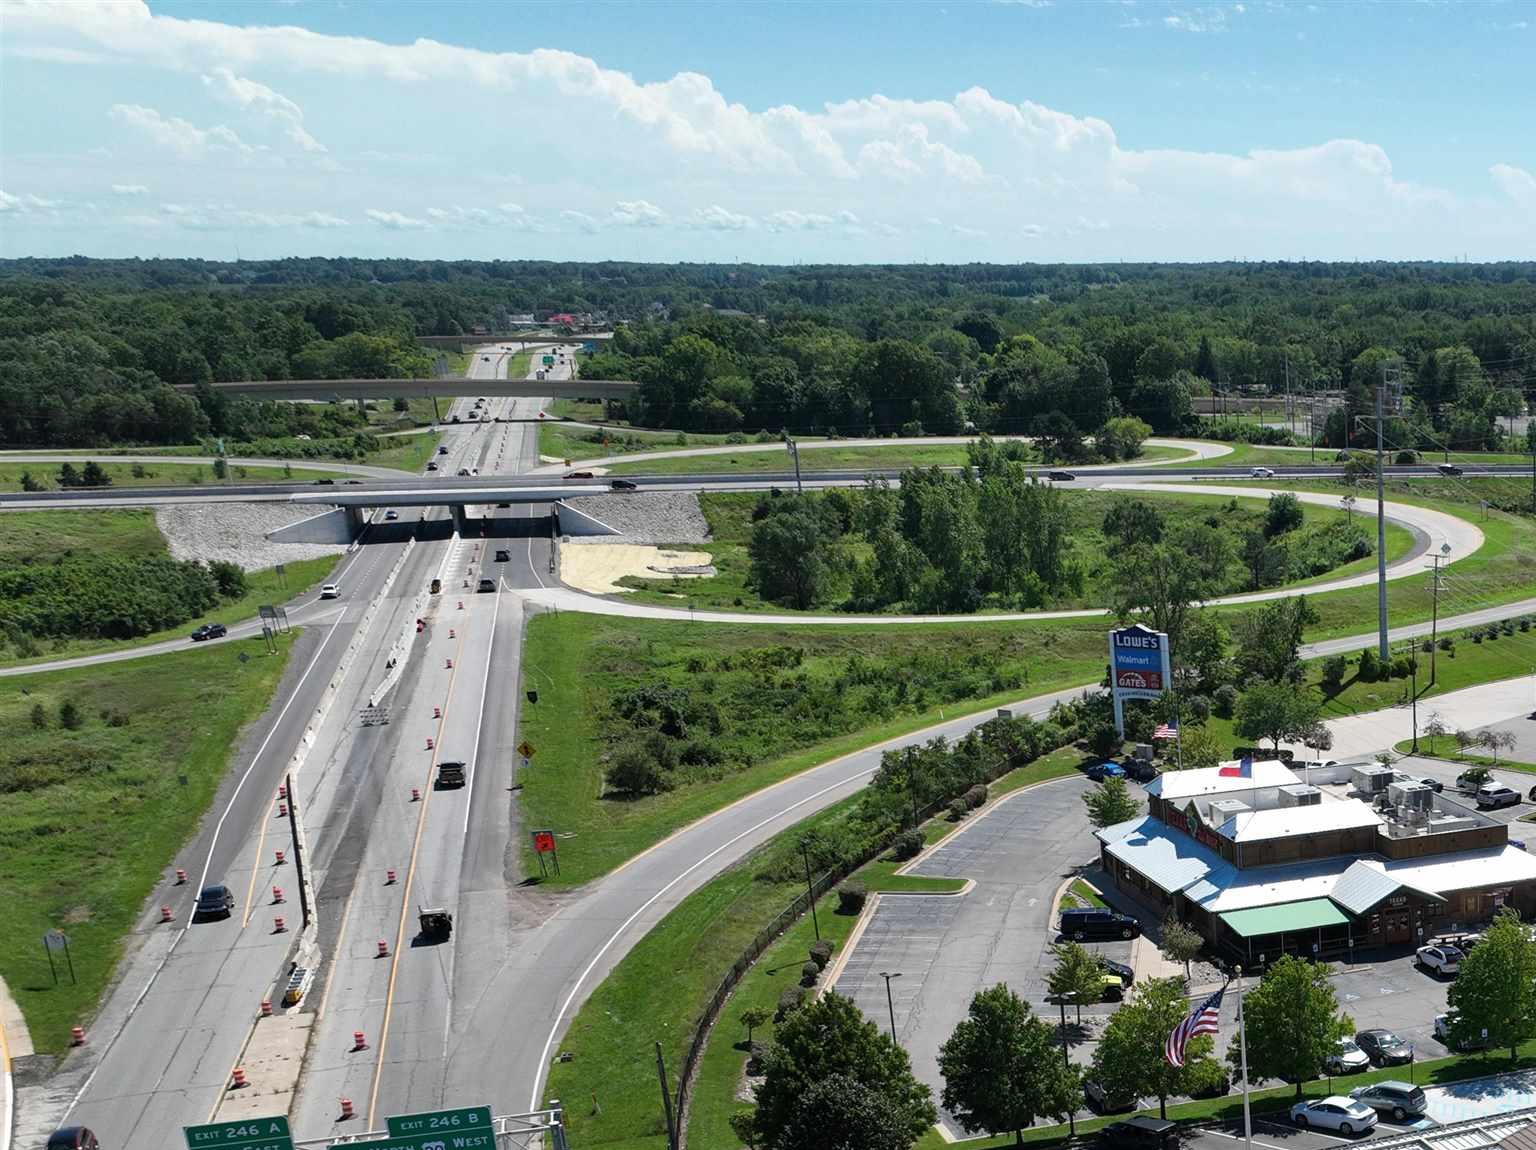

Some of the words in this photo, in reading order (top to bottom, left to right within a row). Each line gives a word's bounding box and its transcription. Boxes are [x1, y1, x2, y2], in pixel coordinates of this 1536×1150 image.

[1116, 634, 1158, 649] LOWE'S
[1118, 656, 1149, 665] Walmart
[1119, 679, 1147, 688] GATES
[401, 1121, 423, 1130] EXIT
[430, 1116, 460, 1129] 246
[469, 1113, 480, 1123] B
[195, 1131, 219, 1141] EXIT
[226, 1125, 259, 1138] 246
[269, 1123, 280, 1133] A
[452, 1136, 488, 1148] WEST
